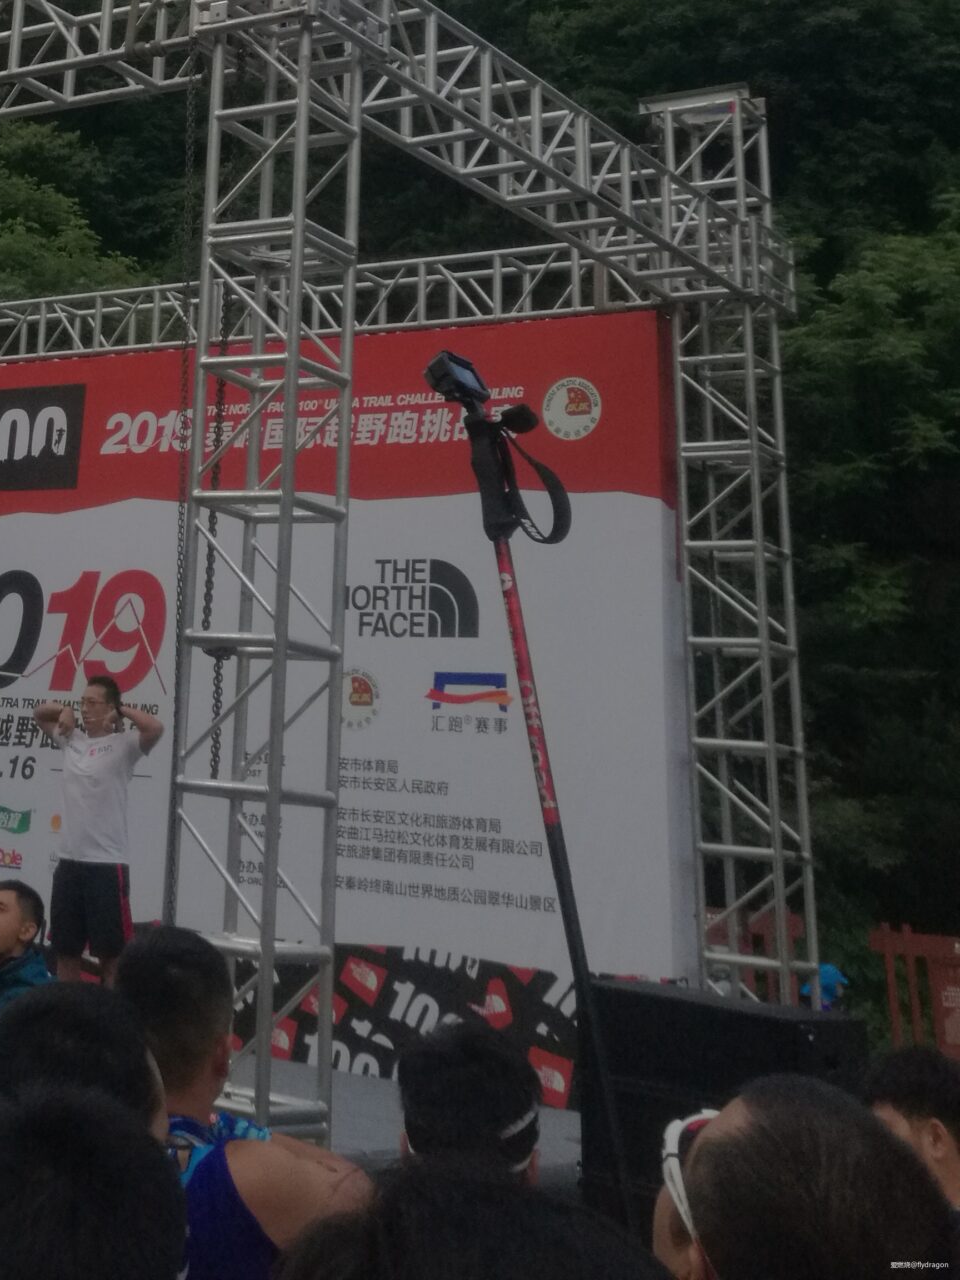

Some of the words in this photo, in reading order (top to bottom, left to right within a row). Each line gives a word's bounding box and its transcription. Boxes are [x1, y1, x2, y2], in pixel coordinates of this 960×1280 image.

[363, 395, 394, 408] TRAIL
[397, 391, 446, 406] CHALLE
[375, 559, 427, 584] THE
[358, 611, 426, 638] FACE
